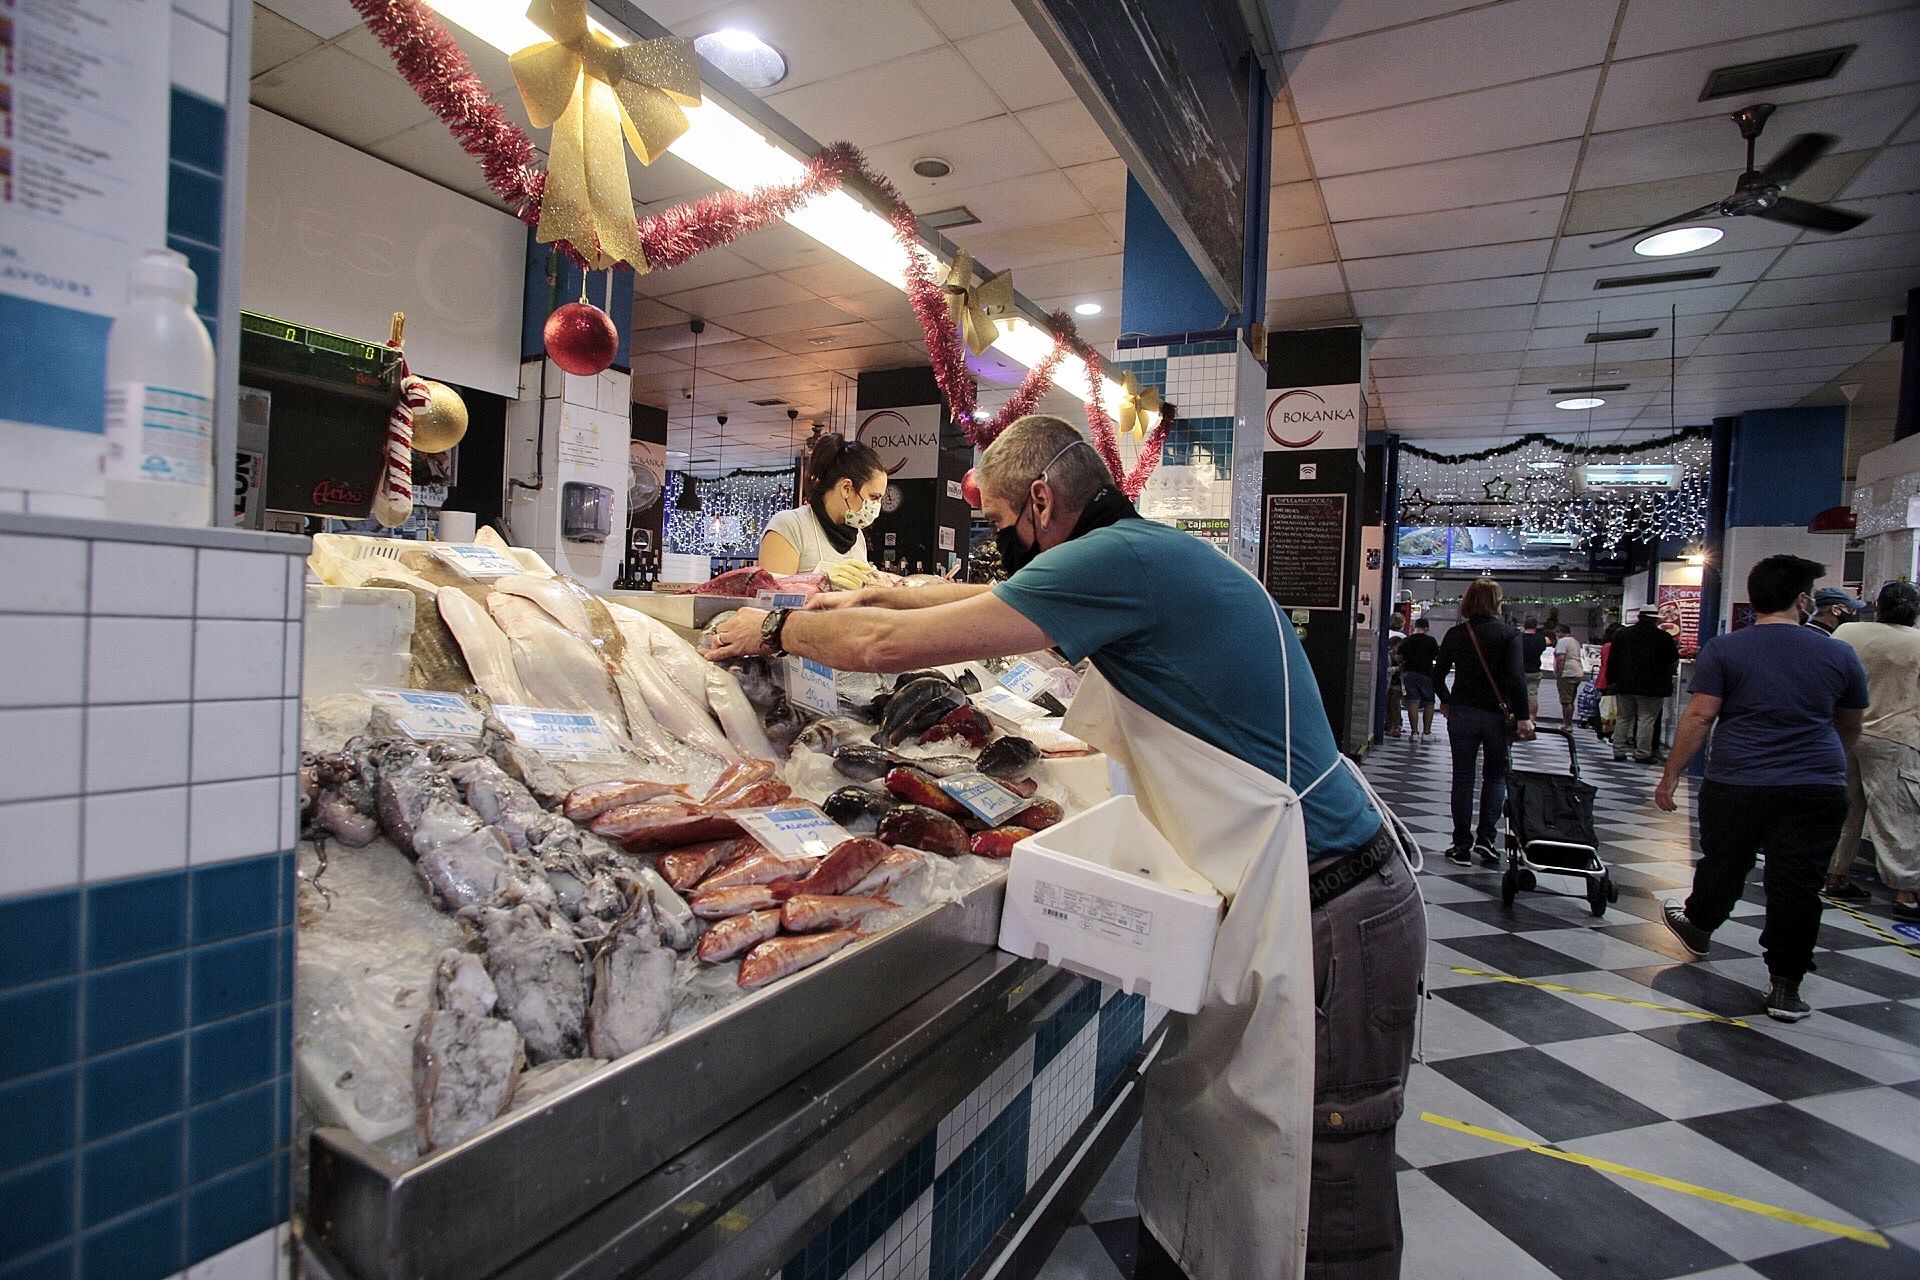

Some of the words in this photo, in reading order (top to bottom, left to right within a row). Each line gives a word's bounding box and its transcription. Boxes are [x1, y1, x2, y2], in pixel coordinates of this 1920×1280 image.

[286, 328, 296, 341] 0
[365, 346, 375, 360] 0
[1283, 408, 1355, 423] BOKANKA
[871, 432, 938, 449] BOKANKA
[1187, 520, 1229, 529] cajasiete
